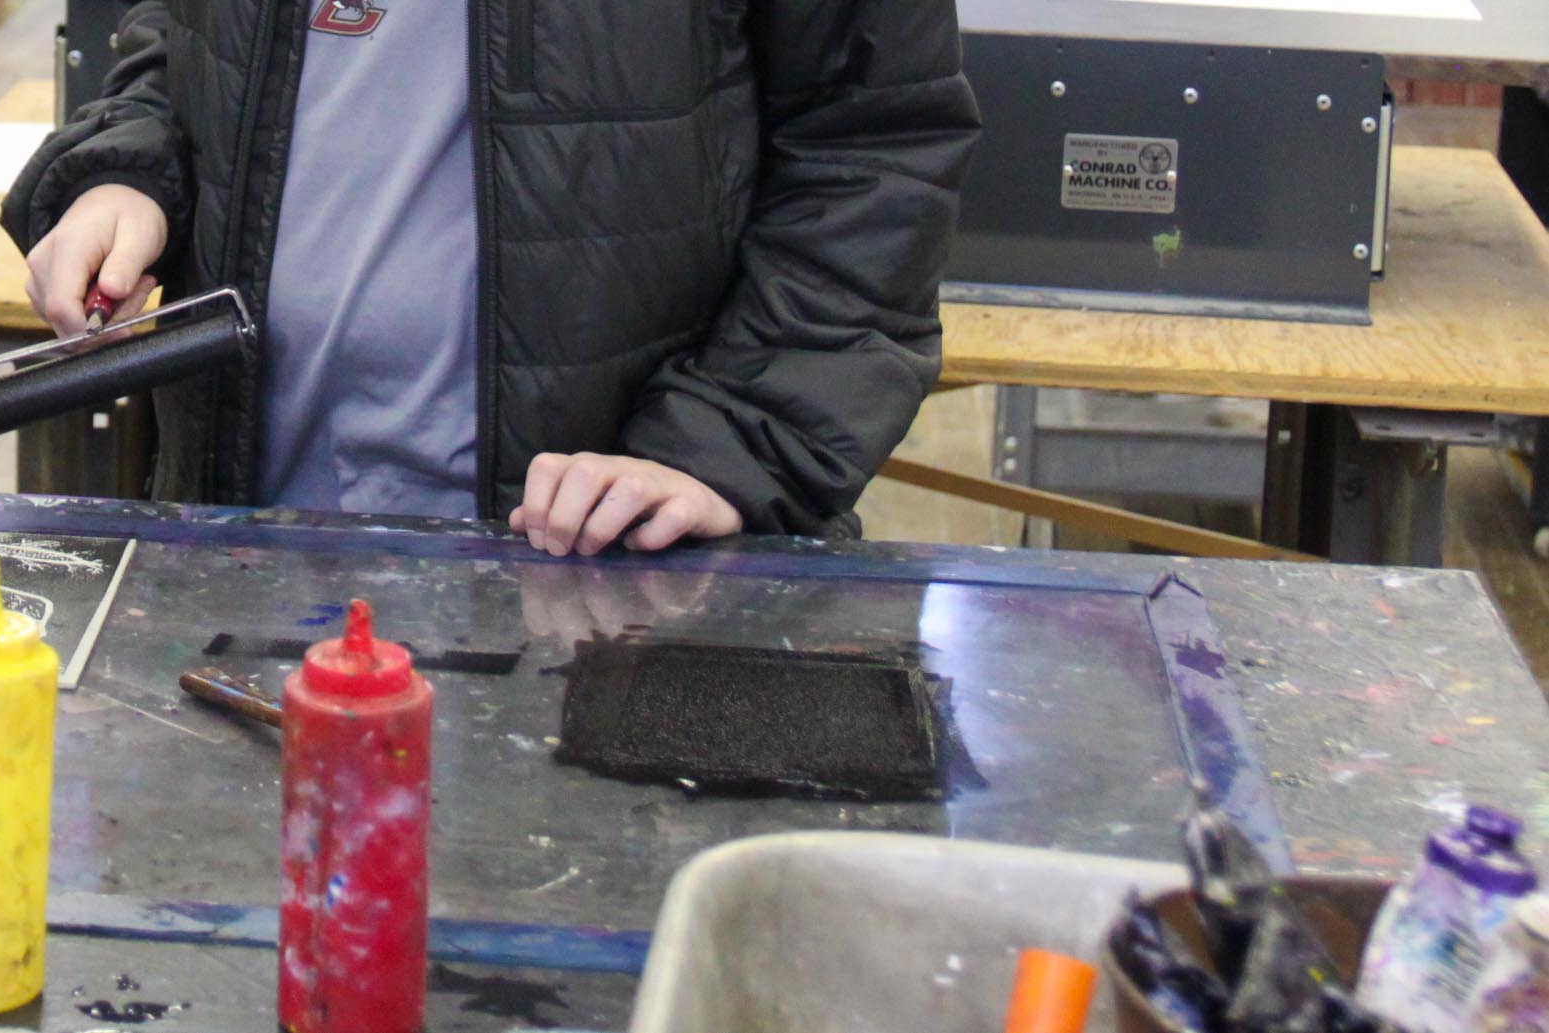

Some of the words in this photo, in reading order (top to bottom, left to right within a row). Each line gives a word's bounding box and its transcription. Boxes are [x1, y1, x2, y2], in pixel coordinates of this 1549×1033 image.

[1070, 160, 1137, 174] CONRAD
[1069, 176, 1141, 190] MACHINE
[1145, 179, 1172, 191] CO.
